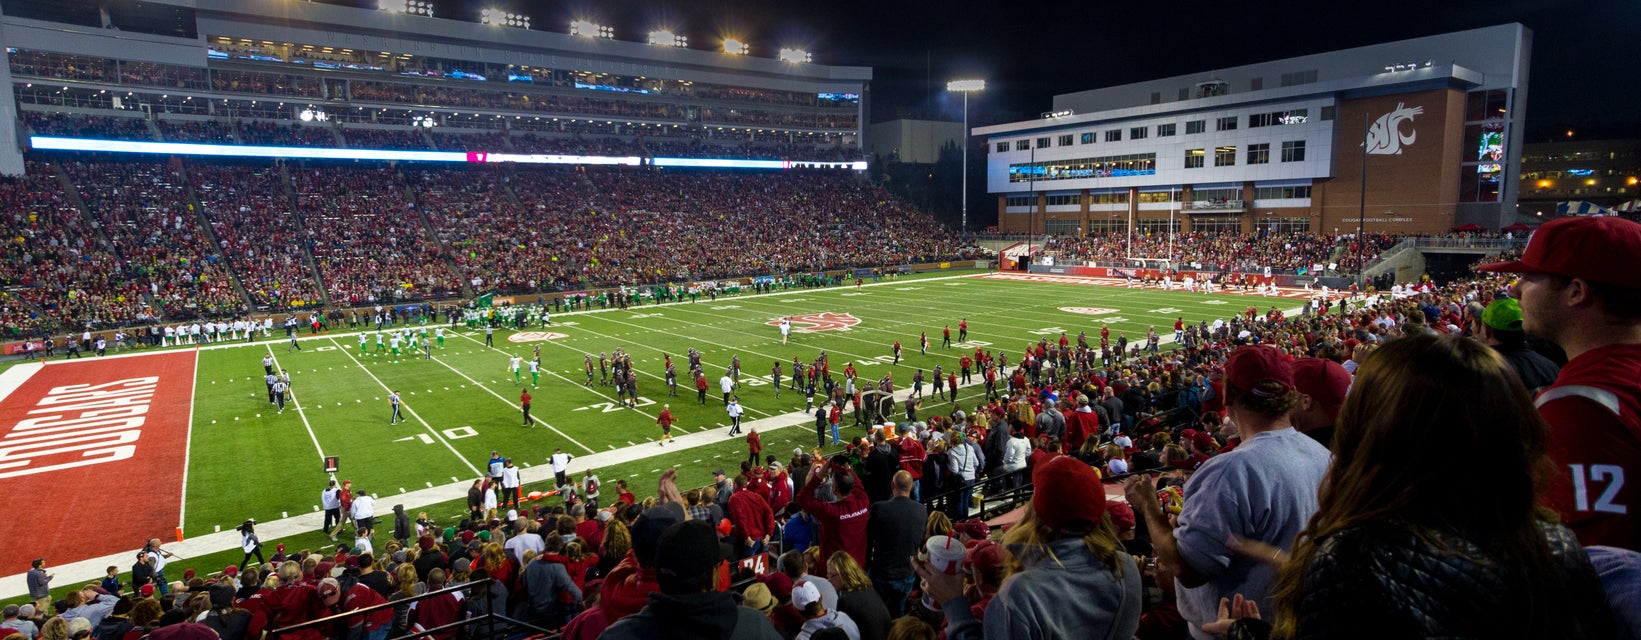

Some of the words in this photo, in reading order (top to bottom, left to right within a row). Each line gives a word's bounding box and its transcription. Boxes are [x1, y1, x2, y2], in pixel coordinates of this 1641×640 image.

[0, 376, 160, 479] COUGARS
[415, 425, 480, 445] 10
[1566, 463, 1628, 515] 12
